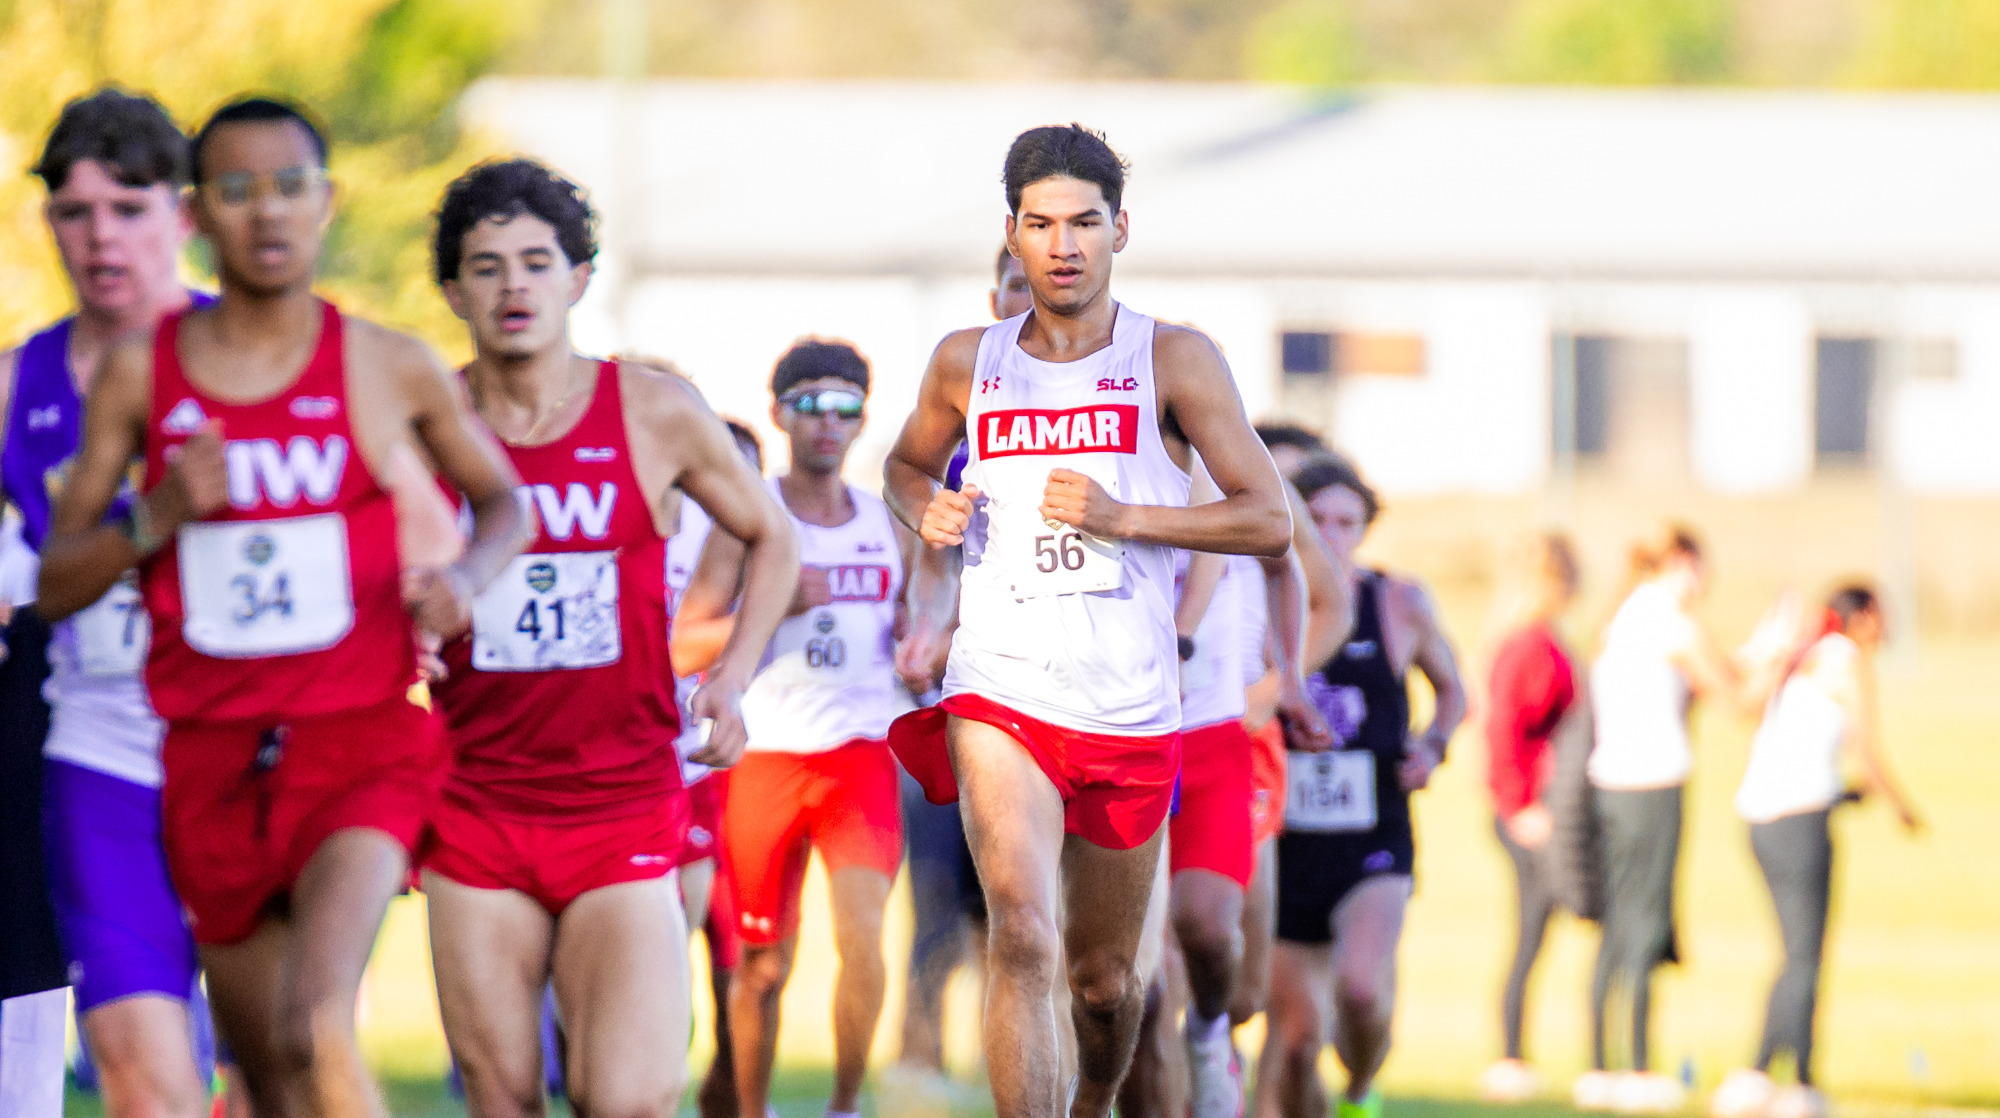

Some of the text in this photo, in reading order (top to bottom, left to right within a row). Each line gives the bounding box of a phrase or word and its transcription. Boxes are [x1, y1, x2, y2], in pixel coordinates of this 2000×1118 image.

[1096, 377, 1136, 391] SLC
[987, 410, 1121, 453] LAMAR
[163, 434, 349, 510] IW
[1035, 532, 1085, 573] 56
[231, 571, 293, 628] 34
[515, 598, 566, 642] 41
[805, 637, 845, 668] 60
